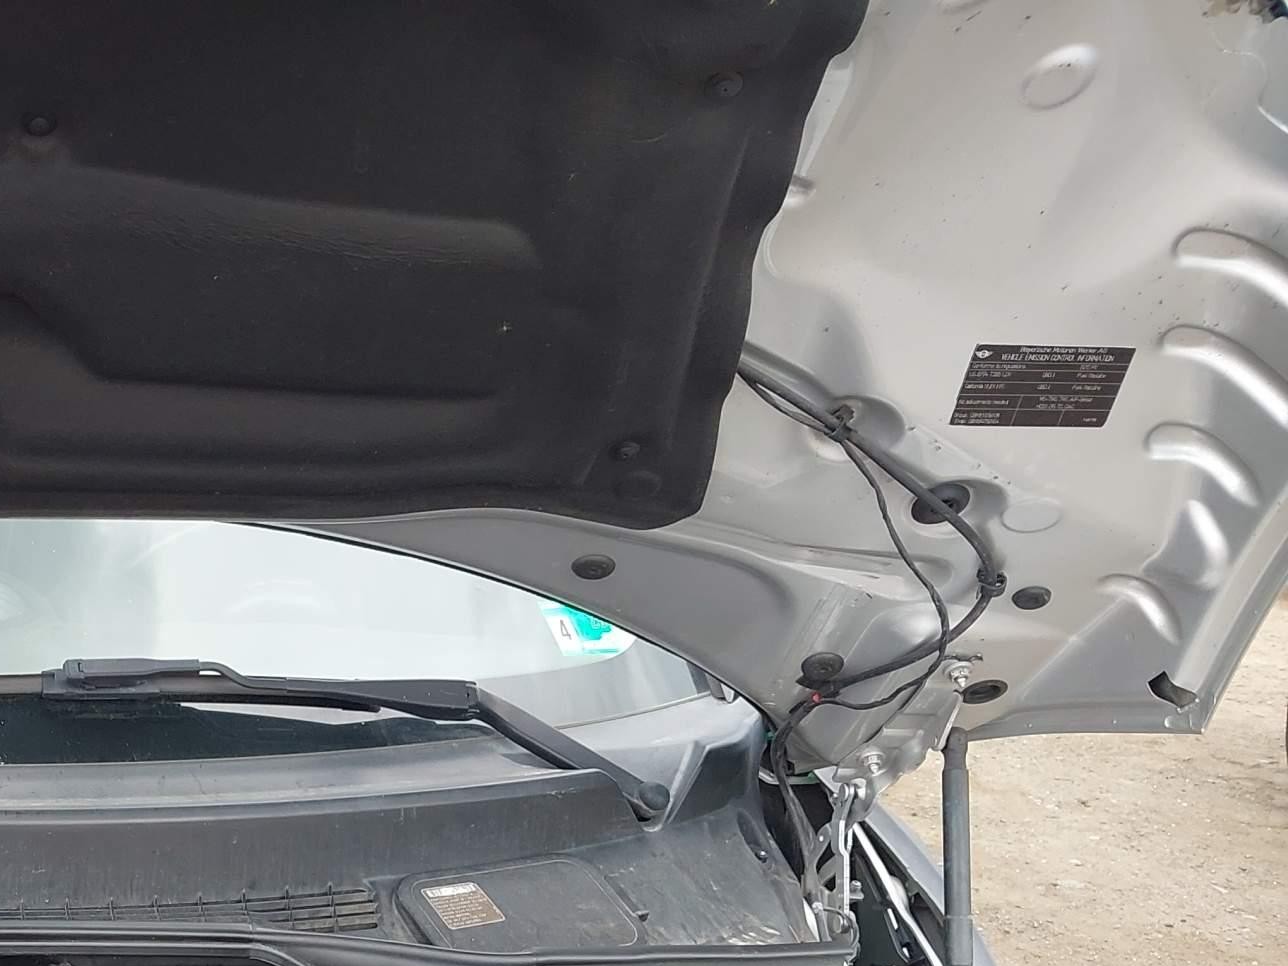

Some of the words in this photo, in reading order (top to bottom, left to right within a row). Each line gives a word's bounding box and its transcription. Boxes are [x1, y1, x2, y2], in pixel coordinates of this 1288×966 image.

[1001, 353, 1024, 361] VEHICLE
[1024, 353, 1050, 361] EMISSION
[1050, 354, 1076, 362] CONTROL
[1077, 354, 1115, 362] INFORMATION
[560, 619, 572, 640] 4
